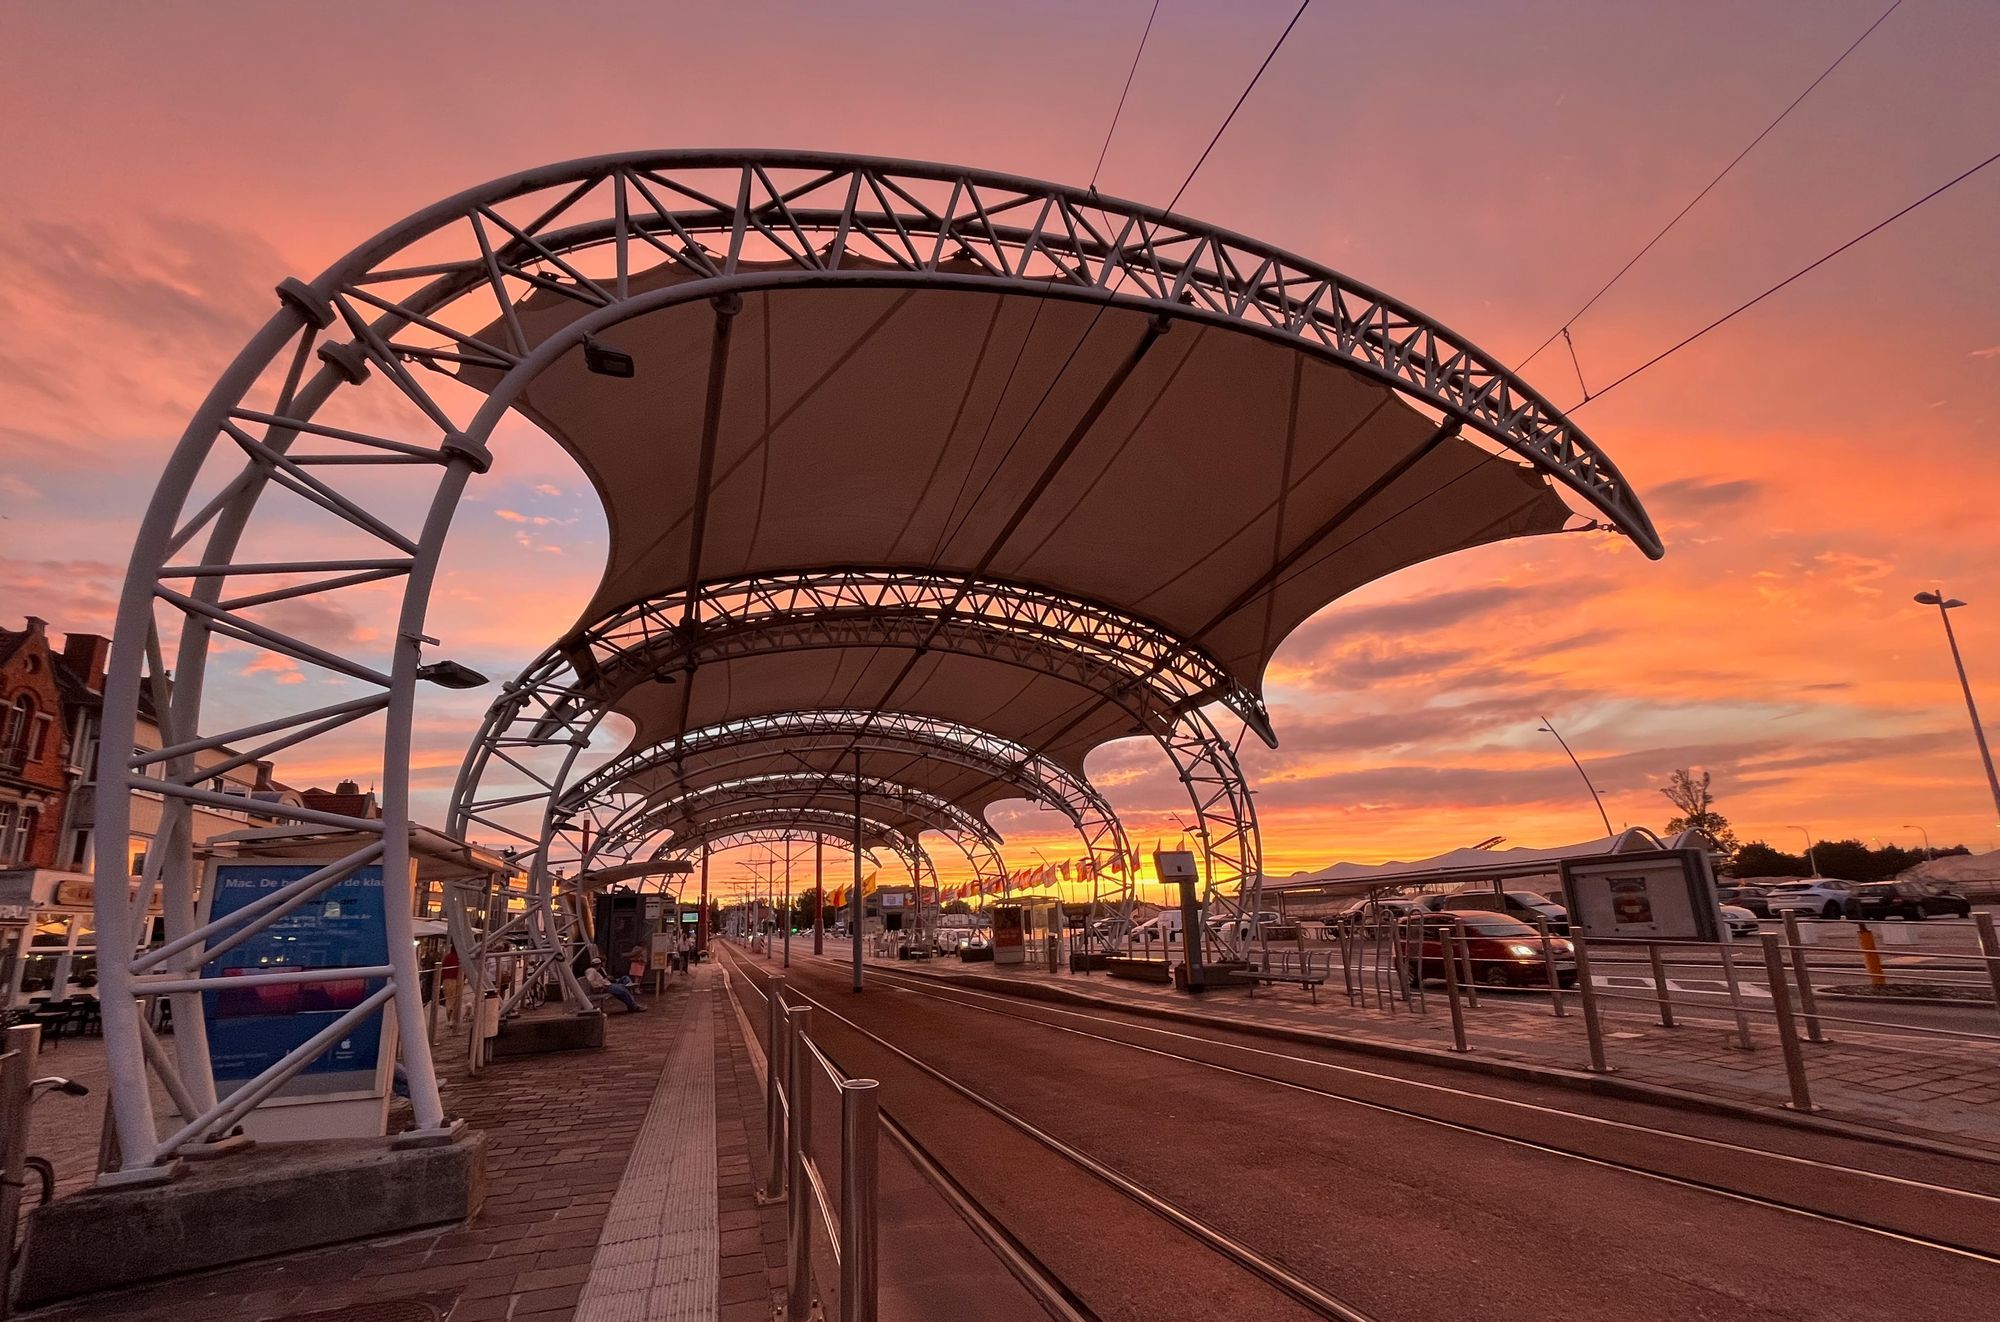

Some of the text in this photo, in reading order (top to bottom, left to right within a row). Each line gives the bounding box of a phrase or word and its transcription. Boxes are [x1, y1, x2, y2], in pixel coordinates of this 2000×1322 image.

[225, 878, 257, 888] Mac.
[260, 878, 278, 888] De
[344, 878, 360, 887] de
